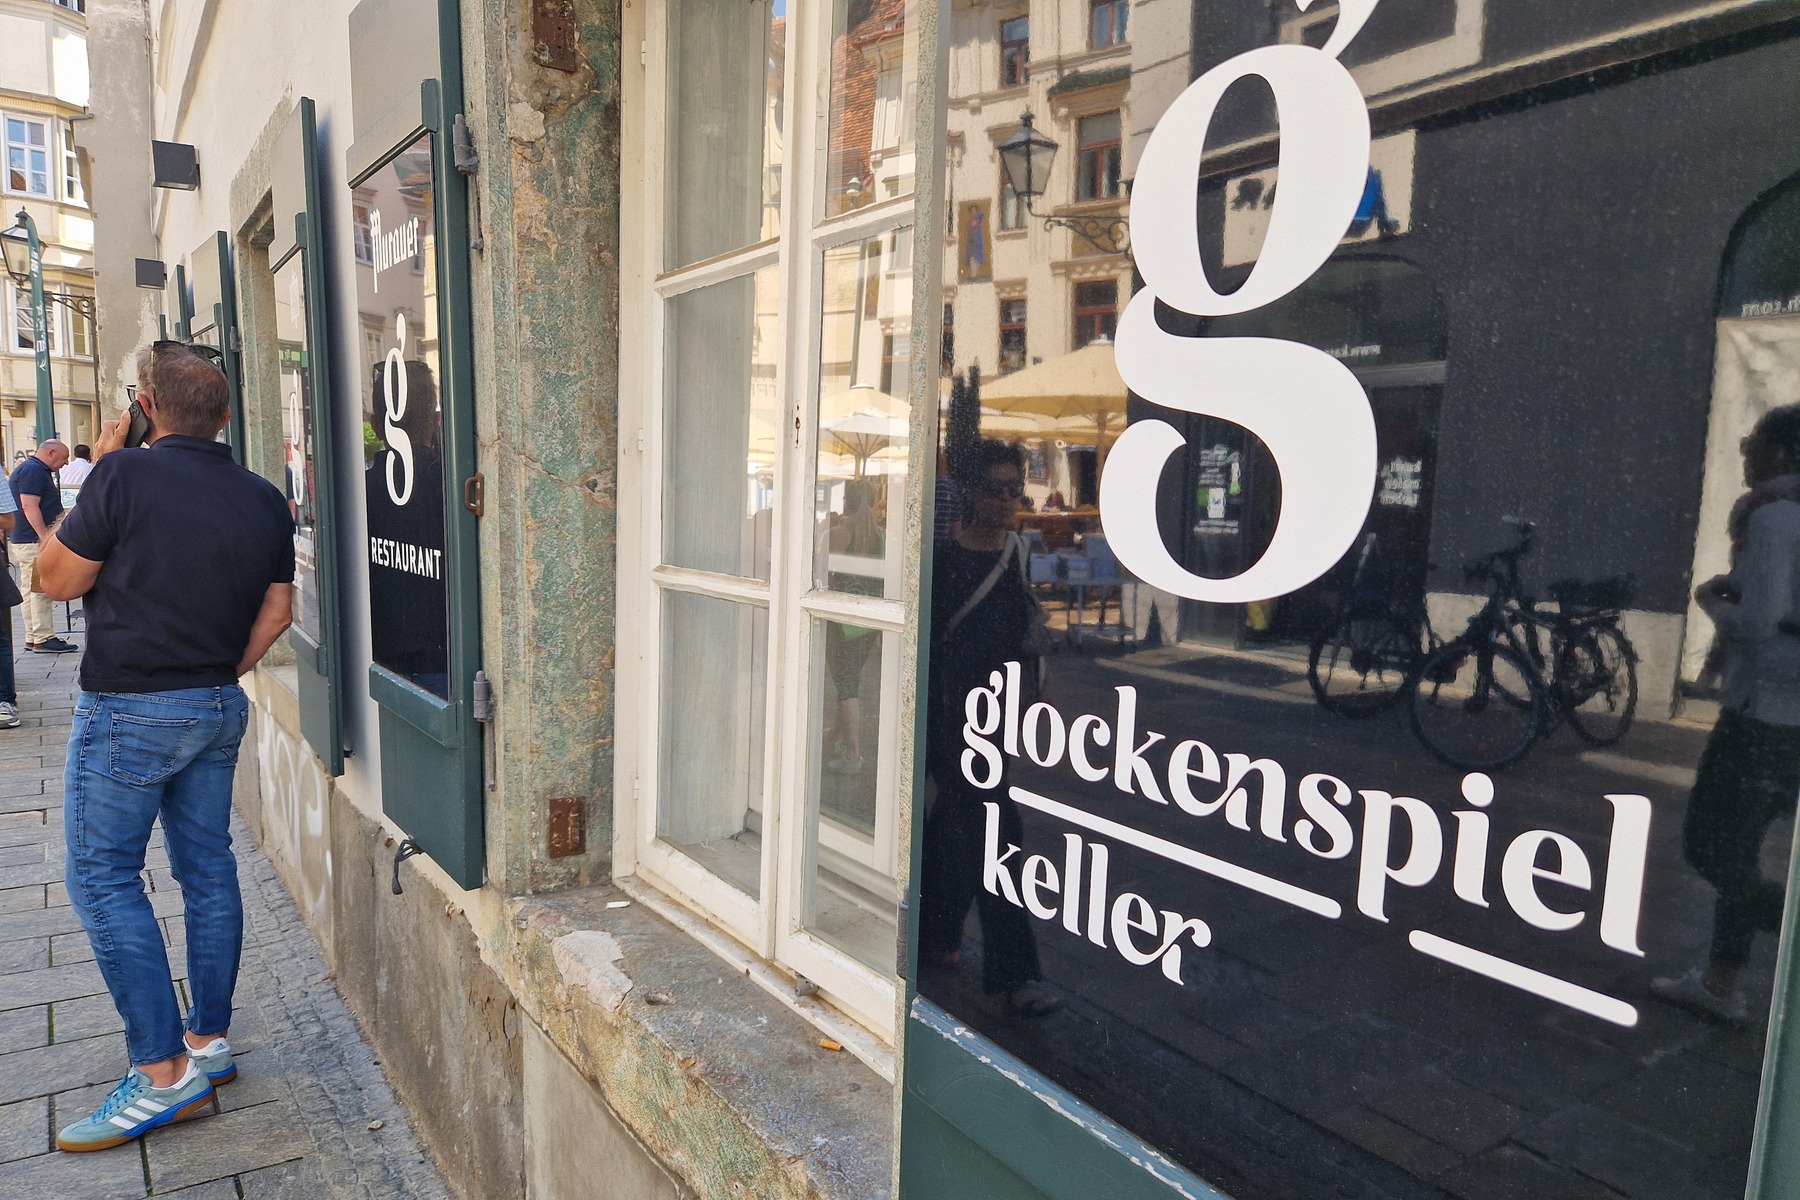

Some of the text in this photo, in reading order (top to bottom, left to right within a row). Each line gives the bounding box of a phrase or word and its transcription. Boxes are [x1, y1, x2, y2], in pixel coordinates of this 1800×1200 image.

[1100, 0, 1378, 603] g
[384, 312, 415, 506] g
[371, 536, 442, 581] RESTAURANT
[960, 661, 1652, 957] glockenspiel
[983, 801, 1212, 986] keller
